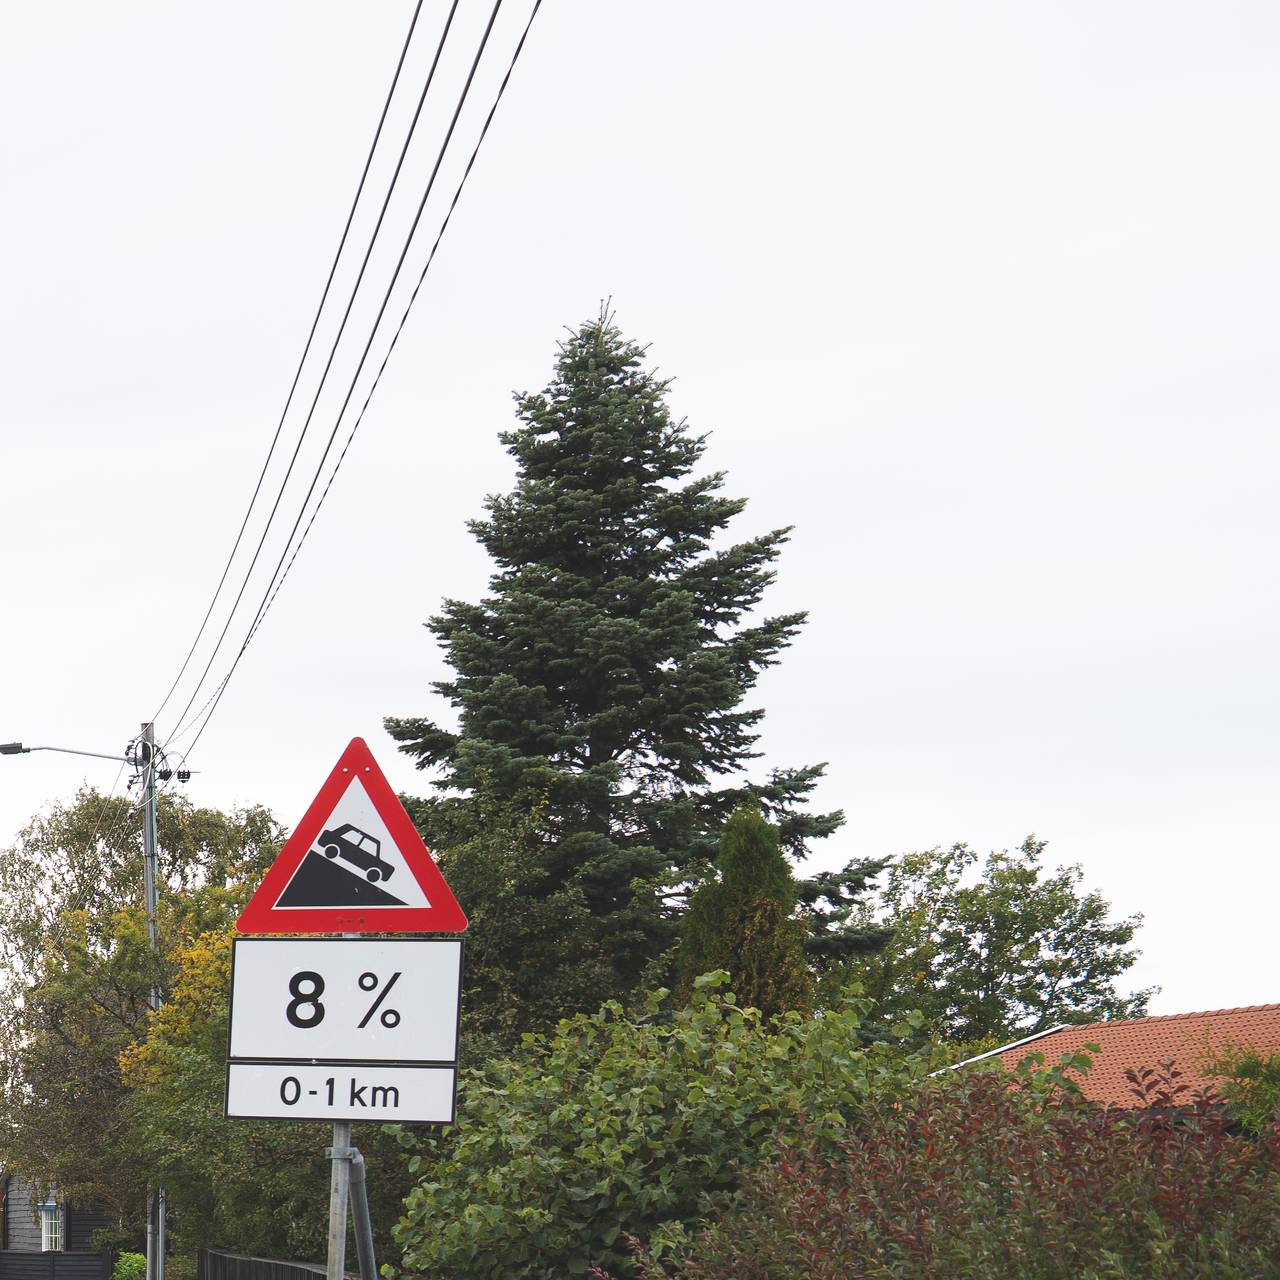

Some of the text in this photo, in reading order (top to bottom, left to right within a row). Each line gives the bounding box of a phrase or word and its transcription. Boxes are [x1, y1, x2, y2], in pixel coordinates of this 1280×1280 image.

[285, 970, 402, 1029] 8 %
[279, 1076, 400, 1108] 0-1 km
